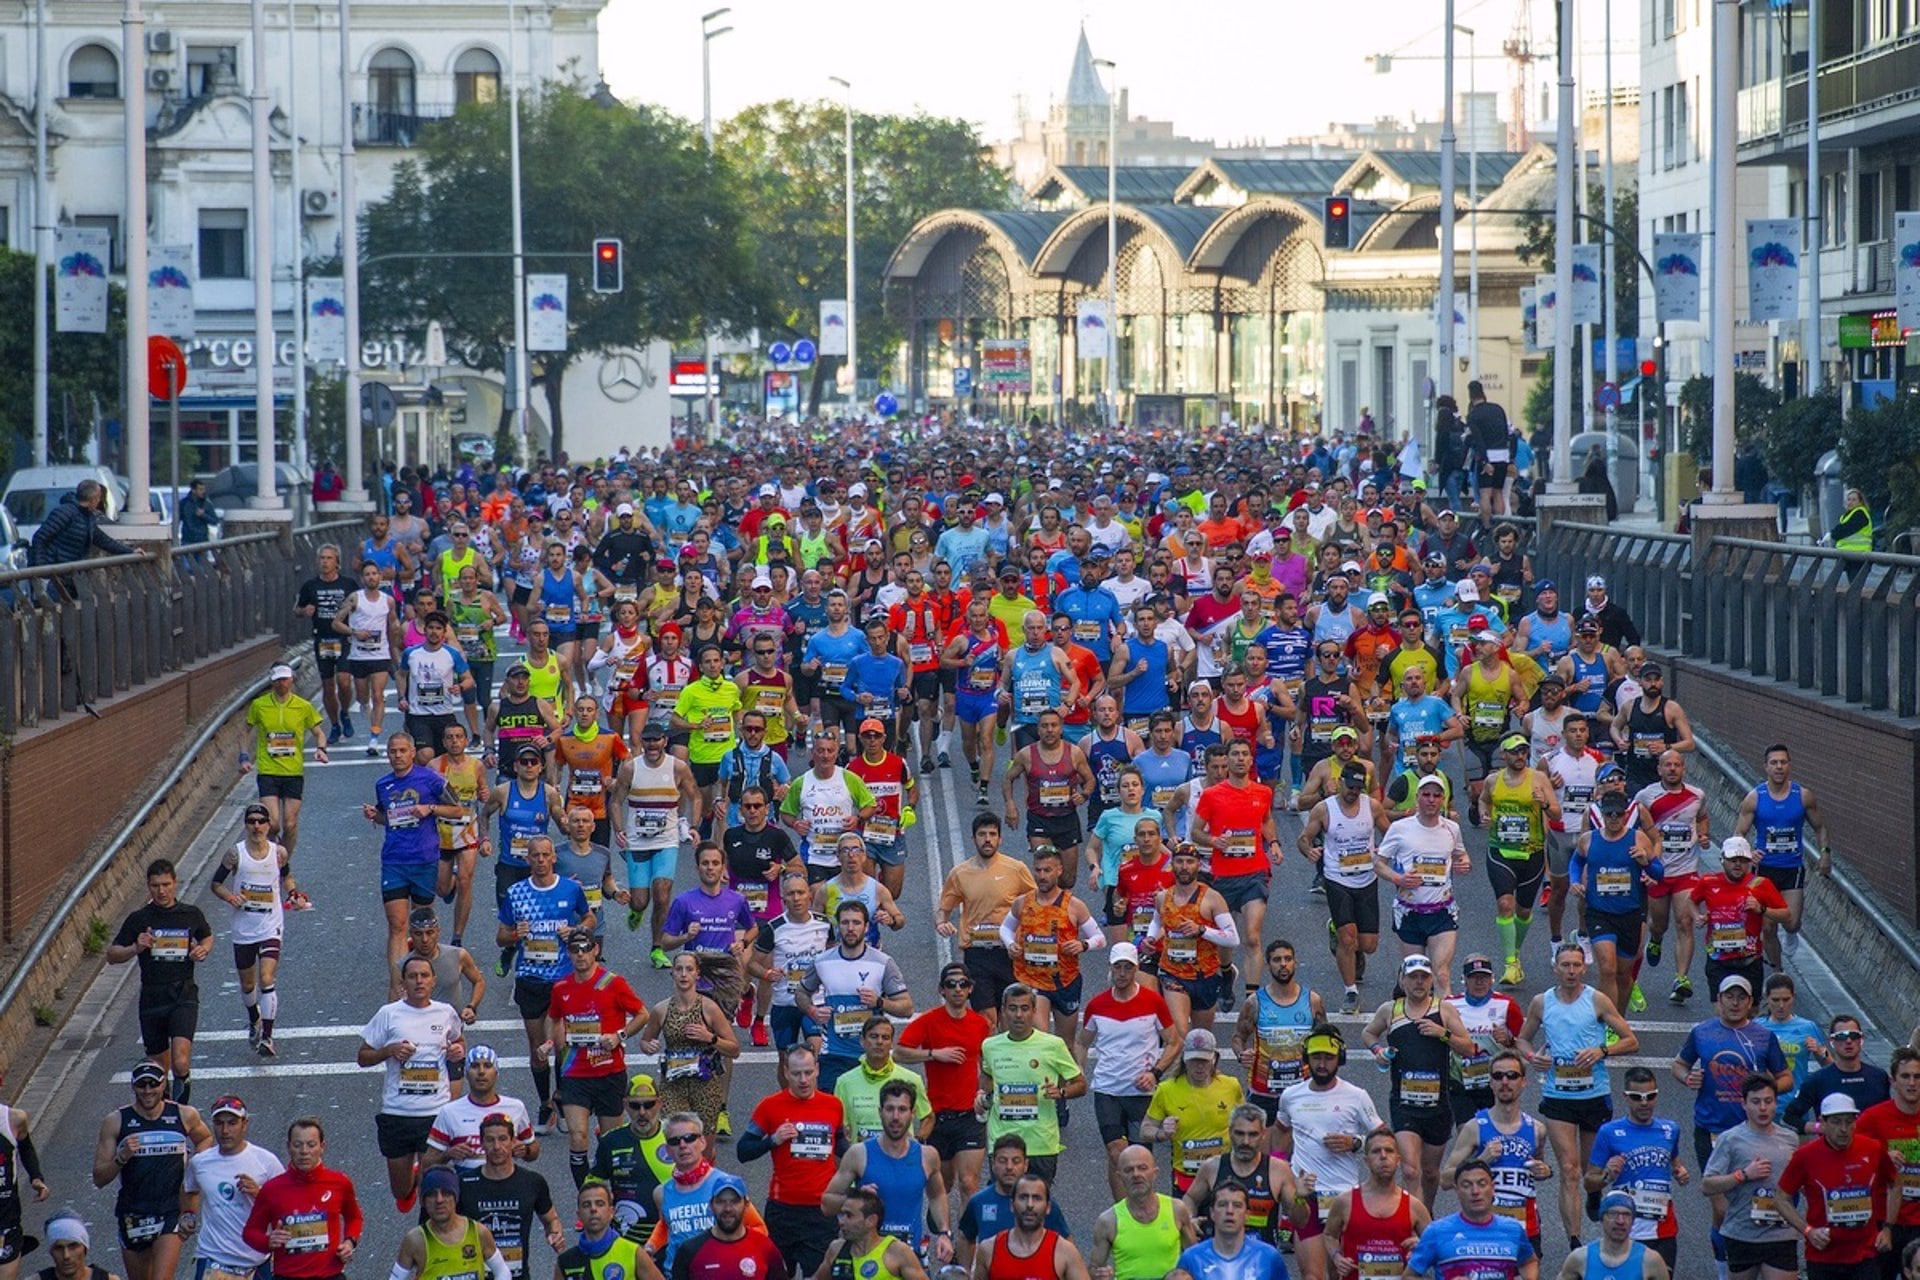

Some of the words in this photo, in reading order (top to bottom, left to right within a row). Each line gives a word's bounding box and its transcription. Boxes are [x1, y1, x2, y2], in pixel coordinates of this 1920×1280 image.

[1842, 1190, 1866, 1198] ZURICH
[669, 1203, 709, 1220] WEEKLY
[296, 1215, 322, 1223] ZURICH
[694, 1216, 716, 1231] RUN
[885, 1224, 910, 1232] ZURICH
[1455, 1246, 1512, 1255] CREDUS
